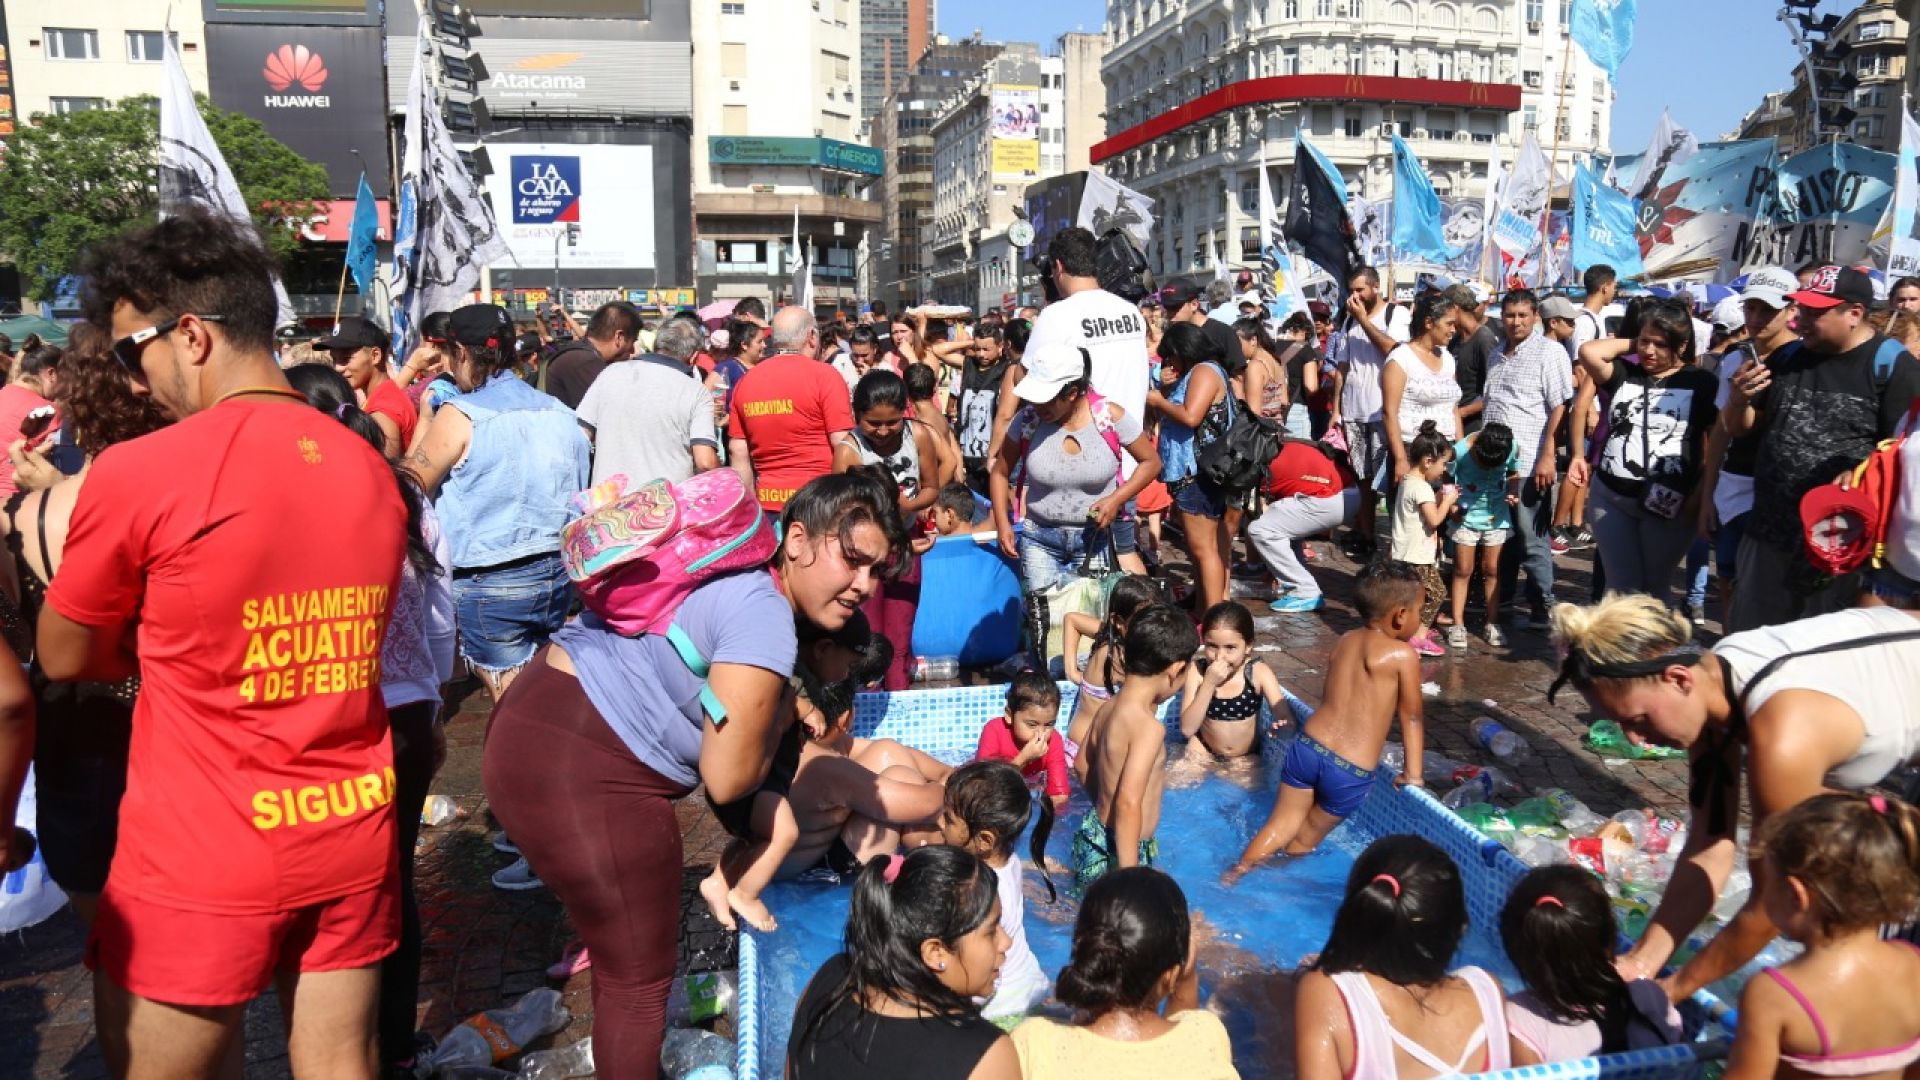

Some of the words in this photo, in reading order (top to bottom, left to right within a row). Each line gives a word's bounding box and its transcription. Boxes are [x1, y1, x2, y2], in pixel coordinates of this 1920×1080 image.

[491, 72, 586, 89] Atacama
[264, 95, 330, 107] HUAWEI
[826, 144, 877, 166] COMERCIO
[531, 163, 561, 180] LA
[518, 179, 573, 199] CAJA
[519, 198, 530, 207] de
[527, 208, 554, 217] seguro
[1750, 276, 1789, 292] adidas
[1081, 313, 1141, 338] SiPreBA
[744, 399, 793, 417] GUARDAVIDAS
[242, 585, 389, 631] SALVAMENTO
[239, 674, 256, 703] 4
[264, 668, 296, 701] DE
